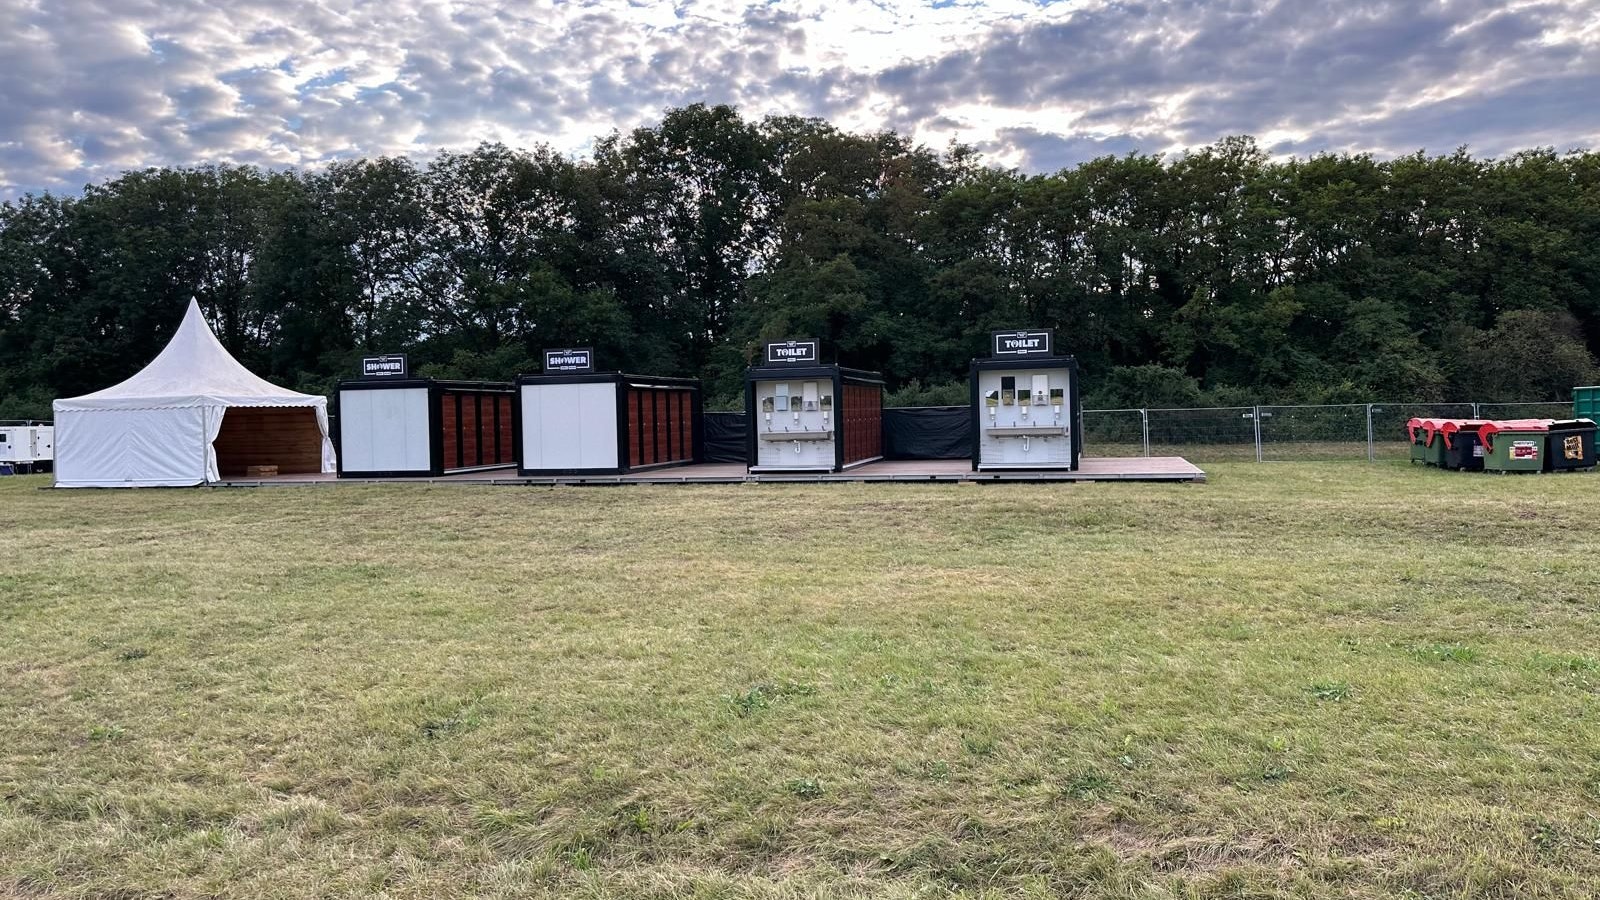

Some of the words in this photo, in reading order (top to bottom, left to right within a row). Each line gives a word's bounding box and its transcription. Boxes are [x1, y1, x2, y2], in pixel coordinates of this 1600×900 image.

[1005, 339, 1039, 348] TOILET
[776, 348, 807, 356] TOILET
[550, 356, 587, 365] SHOWER
[366, 362, 400, 370] SHOWER
